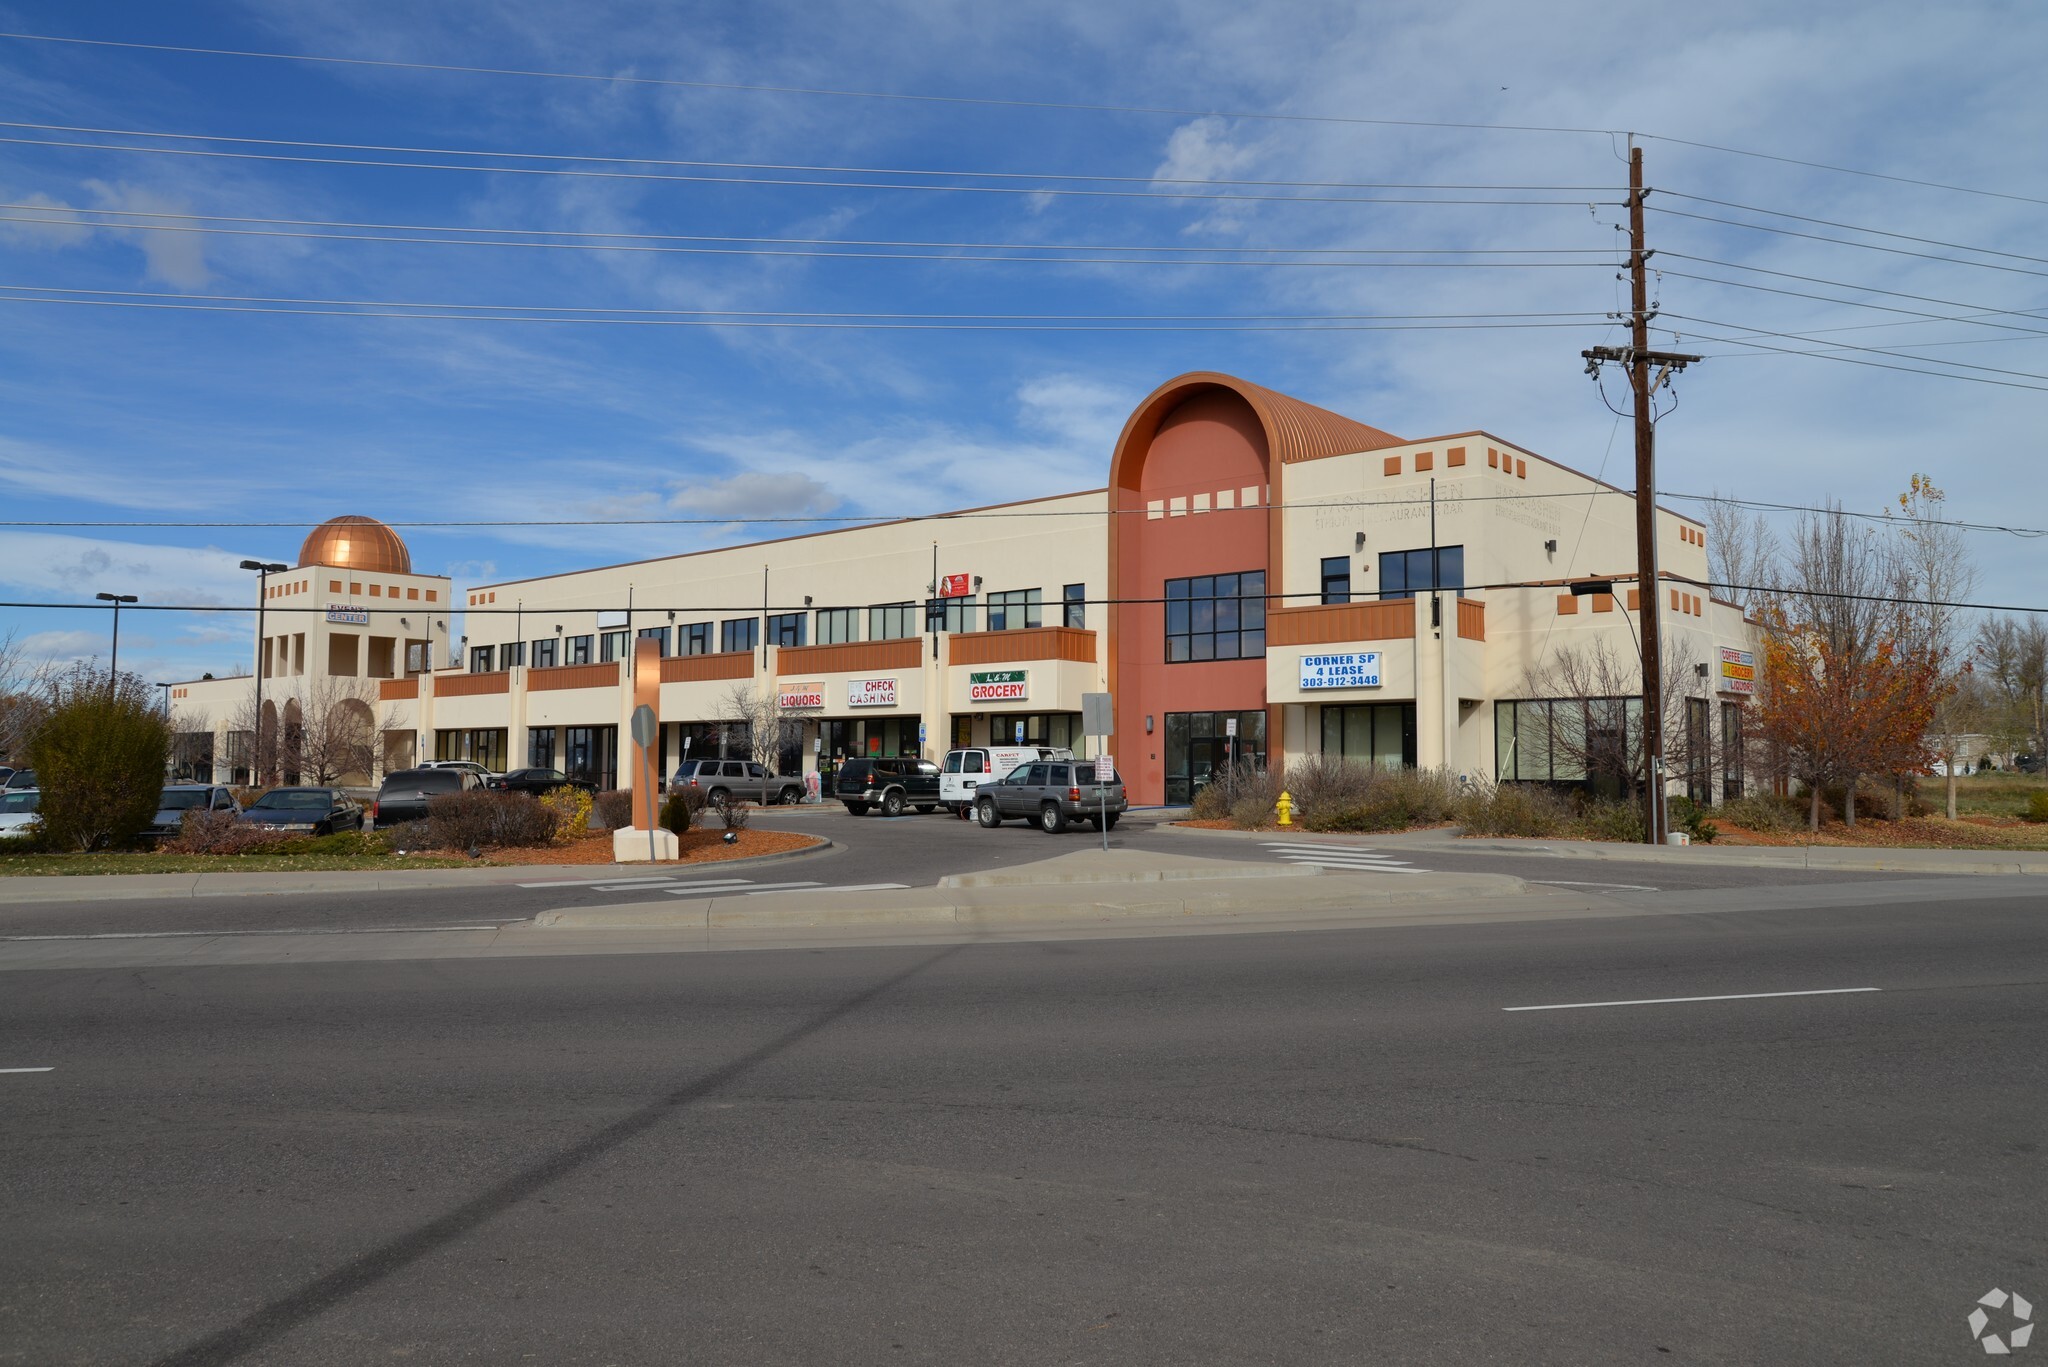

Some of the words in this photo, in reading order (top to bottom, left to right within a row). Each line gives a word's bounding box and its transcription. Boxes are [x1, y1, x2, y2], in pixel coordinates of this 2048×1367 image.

[328, 612, 366, 623] CENTER
[1305, 655, 1354, 666] CORNER
[1358, 654, 1375, 664] SP
[1722, 649, 1740, 663] COFFEE
[1316, 667, 1324, 676] 4
[1328, 665, 1364, 676] LEASE
[1730, 665, 1753, 680] GROCERY
[994, 674, 1000, 682] &
[1302, 675, 1378, 687] 303-912-3448
[865, 681, 894, 693] CHECK
[972, 684, 1024, 699] GROCERY
[781, 694, 821, 707] LIQUORS
[849, 692, 894, 704] CASHING
